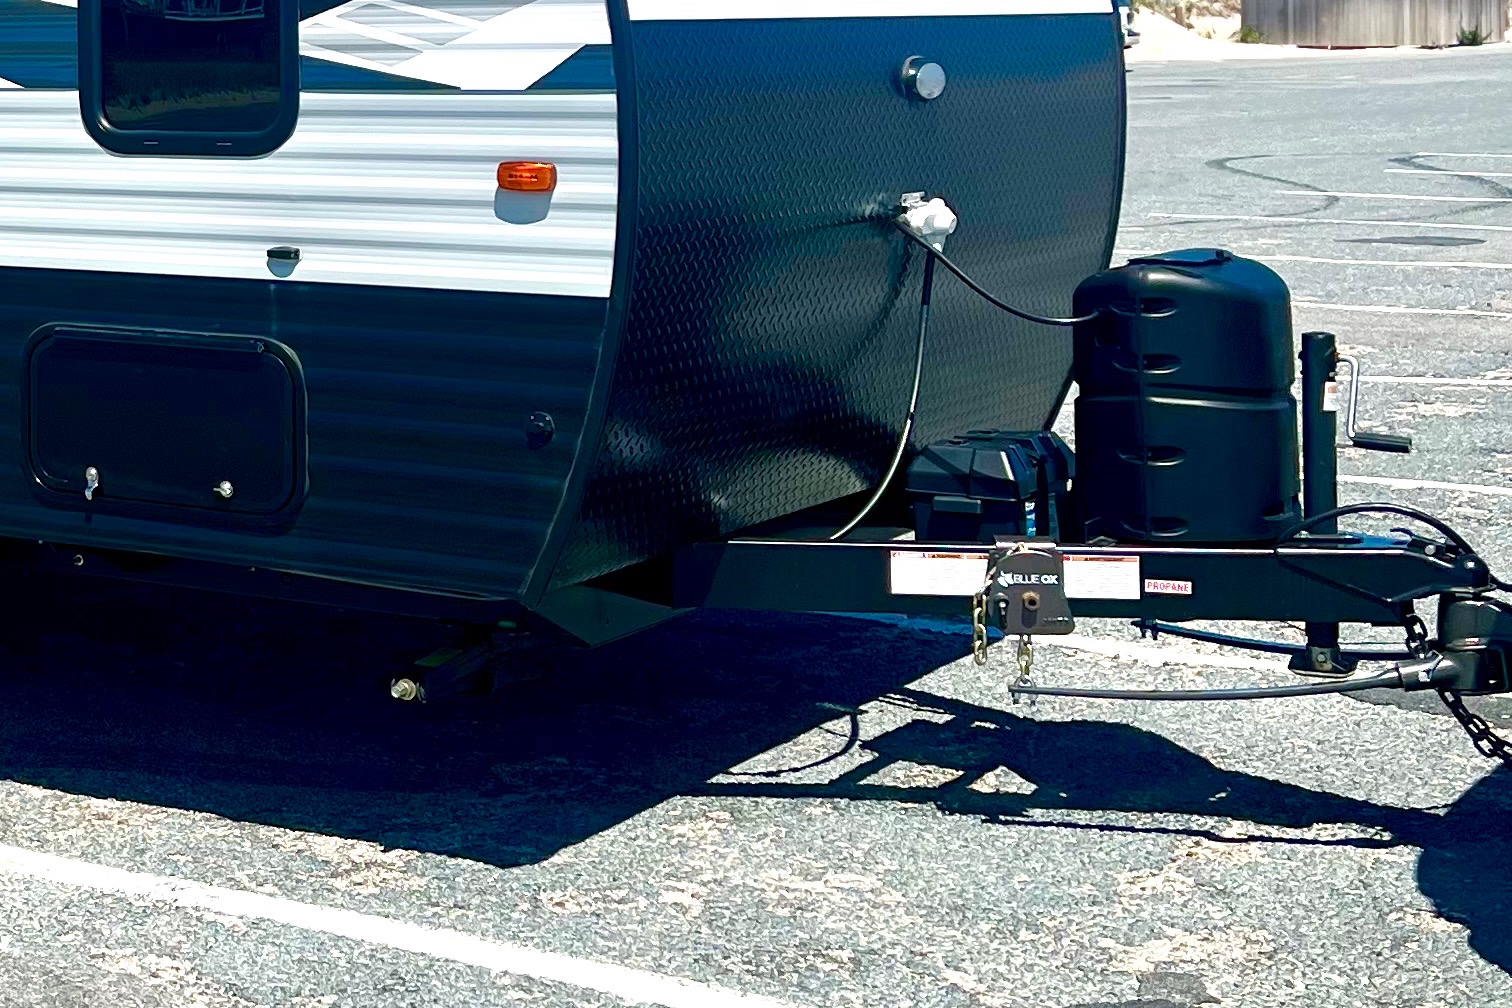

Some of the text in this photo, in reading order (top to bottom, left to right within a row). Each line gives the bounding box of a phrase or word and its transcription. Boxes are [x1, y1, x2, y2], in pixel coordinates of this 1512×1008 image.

[1013, 573, 1059, 585] BLUE OX
[1147, 581, 1189, 592] PROPANE
